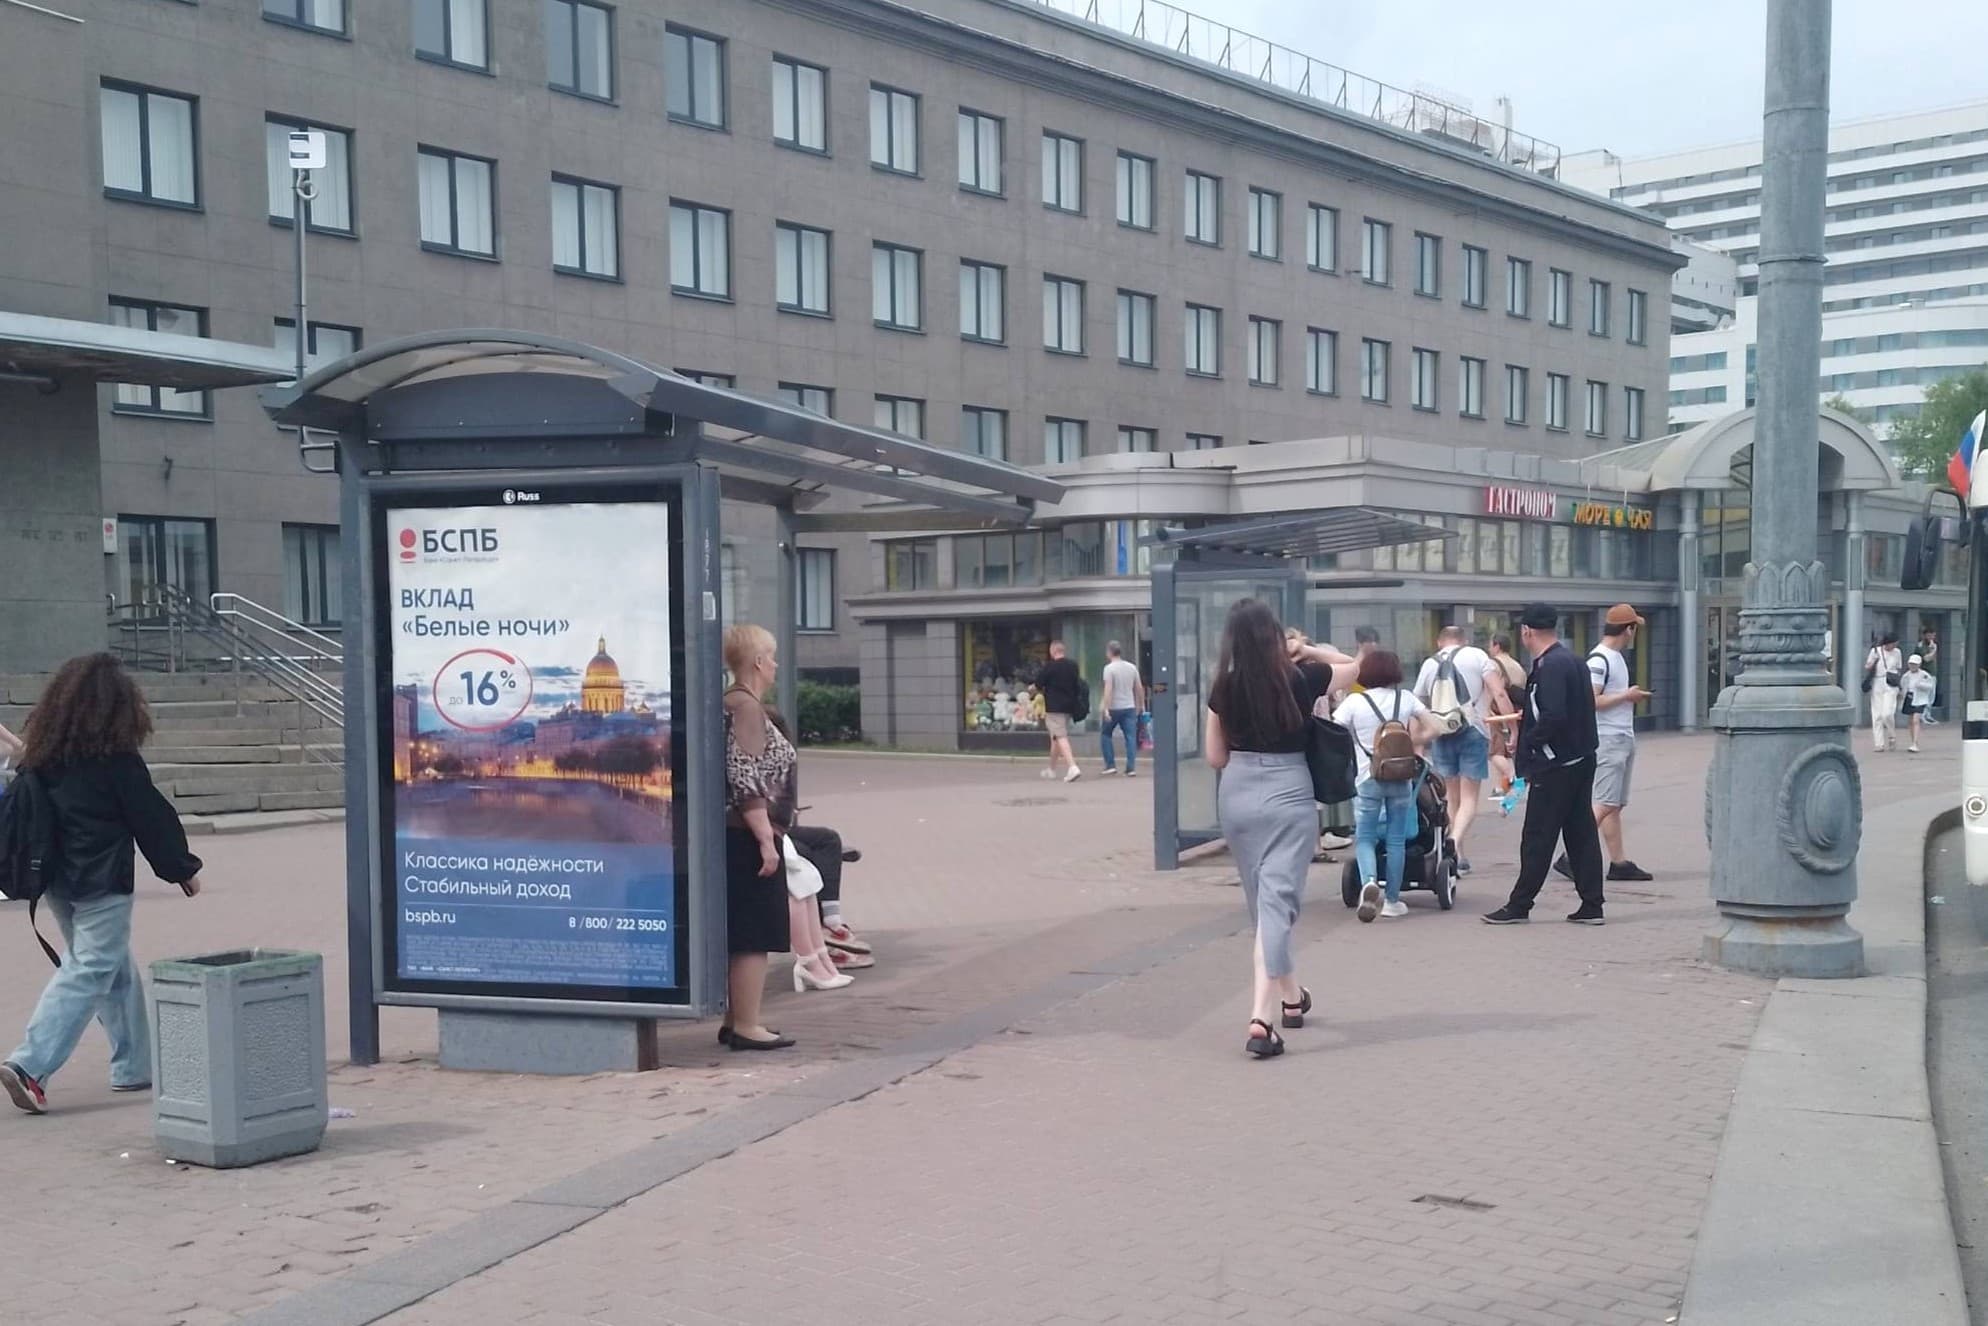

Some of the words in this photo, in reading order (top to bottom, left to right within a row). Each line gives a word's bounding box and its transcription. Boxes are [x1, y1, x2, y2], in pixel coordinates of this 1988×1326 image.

[517, 491, 540, 501] Russ
[1488, 486, 1557, 519] ГАСТРОНОМ
[1574, 502, 1611, 526] МОРЕ
[423, 528, 498, 553] БСПБ
[401, 588, 474, 611] ВКЛАД
[402, 615, 490, 636] «Белые
[498, 618, 570, 636] ночи»
[460, 670, 516, 706] 16%
[405, 851, 488, 870] Классика
[494, 856, 604, 874] надёжности
[405, 875, 512, 895] Стабильный
[516, 883, 572, 900] доход
[405, 908, 456, 925] bspb.ru
[616, 918, 636, 930] 222
[638, 919, 667, 931] 5050
